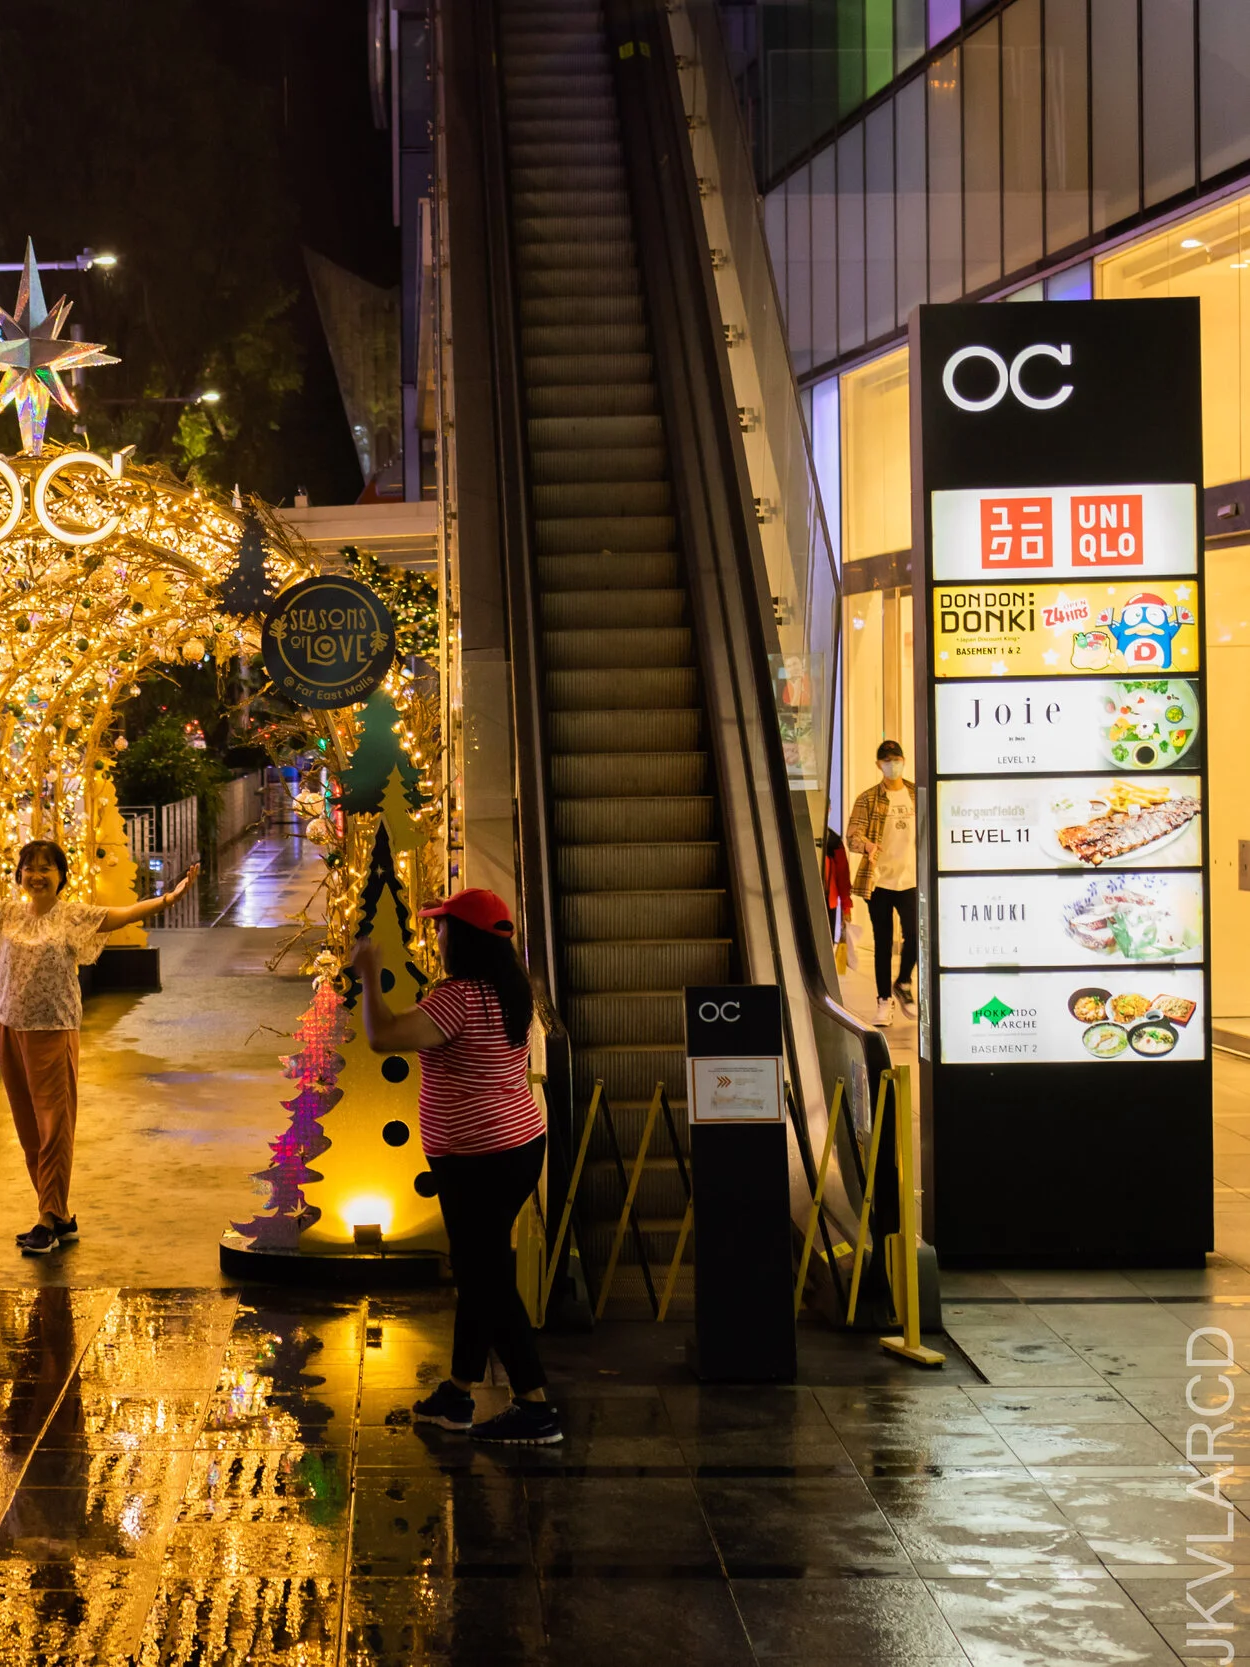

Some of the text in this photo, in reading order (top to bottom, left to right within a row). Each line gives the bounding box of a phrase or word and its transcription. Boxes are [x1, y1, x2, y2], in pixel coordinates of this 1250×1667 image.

[942, 344, 1074, 411] OC
[989, 505, 1043, 531] ユニ
[1078, 503, 1130, 529] UNI
[989, 536, 1044, 561] クロ
[1079, 533, 1135, 562] QLO
[290, 608, 367, 633] SEASONS
[940, 609, 1035, 634] DONKI
[307, 634, 368, 666] LOVE
[956, 647, 997, 656] BASEMENT
[1016, 646, 1021, 654] 2
[1134, 642, 1157, 662] D
[283, 675, 375, 701] @ Far East Malls
[966, 697, 1061, 729] Joie
[997, 756, 1024, 764] LEVEL
[951, 805, 1025, 819] Morganfield's
[950, 828, 1030, 843] LEVEL 11
[960, 904, 1026, 921] TANUKI
[969, 946, 1008, 955] LEVEL
[698, 1001, 741, 1022] OC
[975, 1008, 1037, 1018] HOKKAIDO
[990, 1020, 1037, 1029] MARCHE
[971, 1044, 1038, 1054] BASEMENT 2
